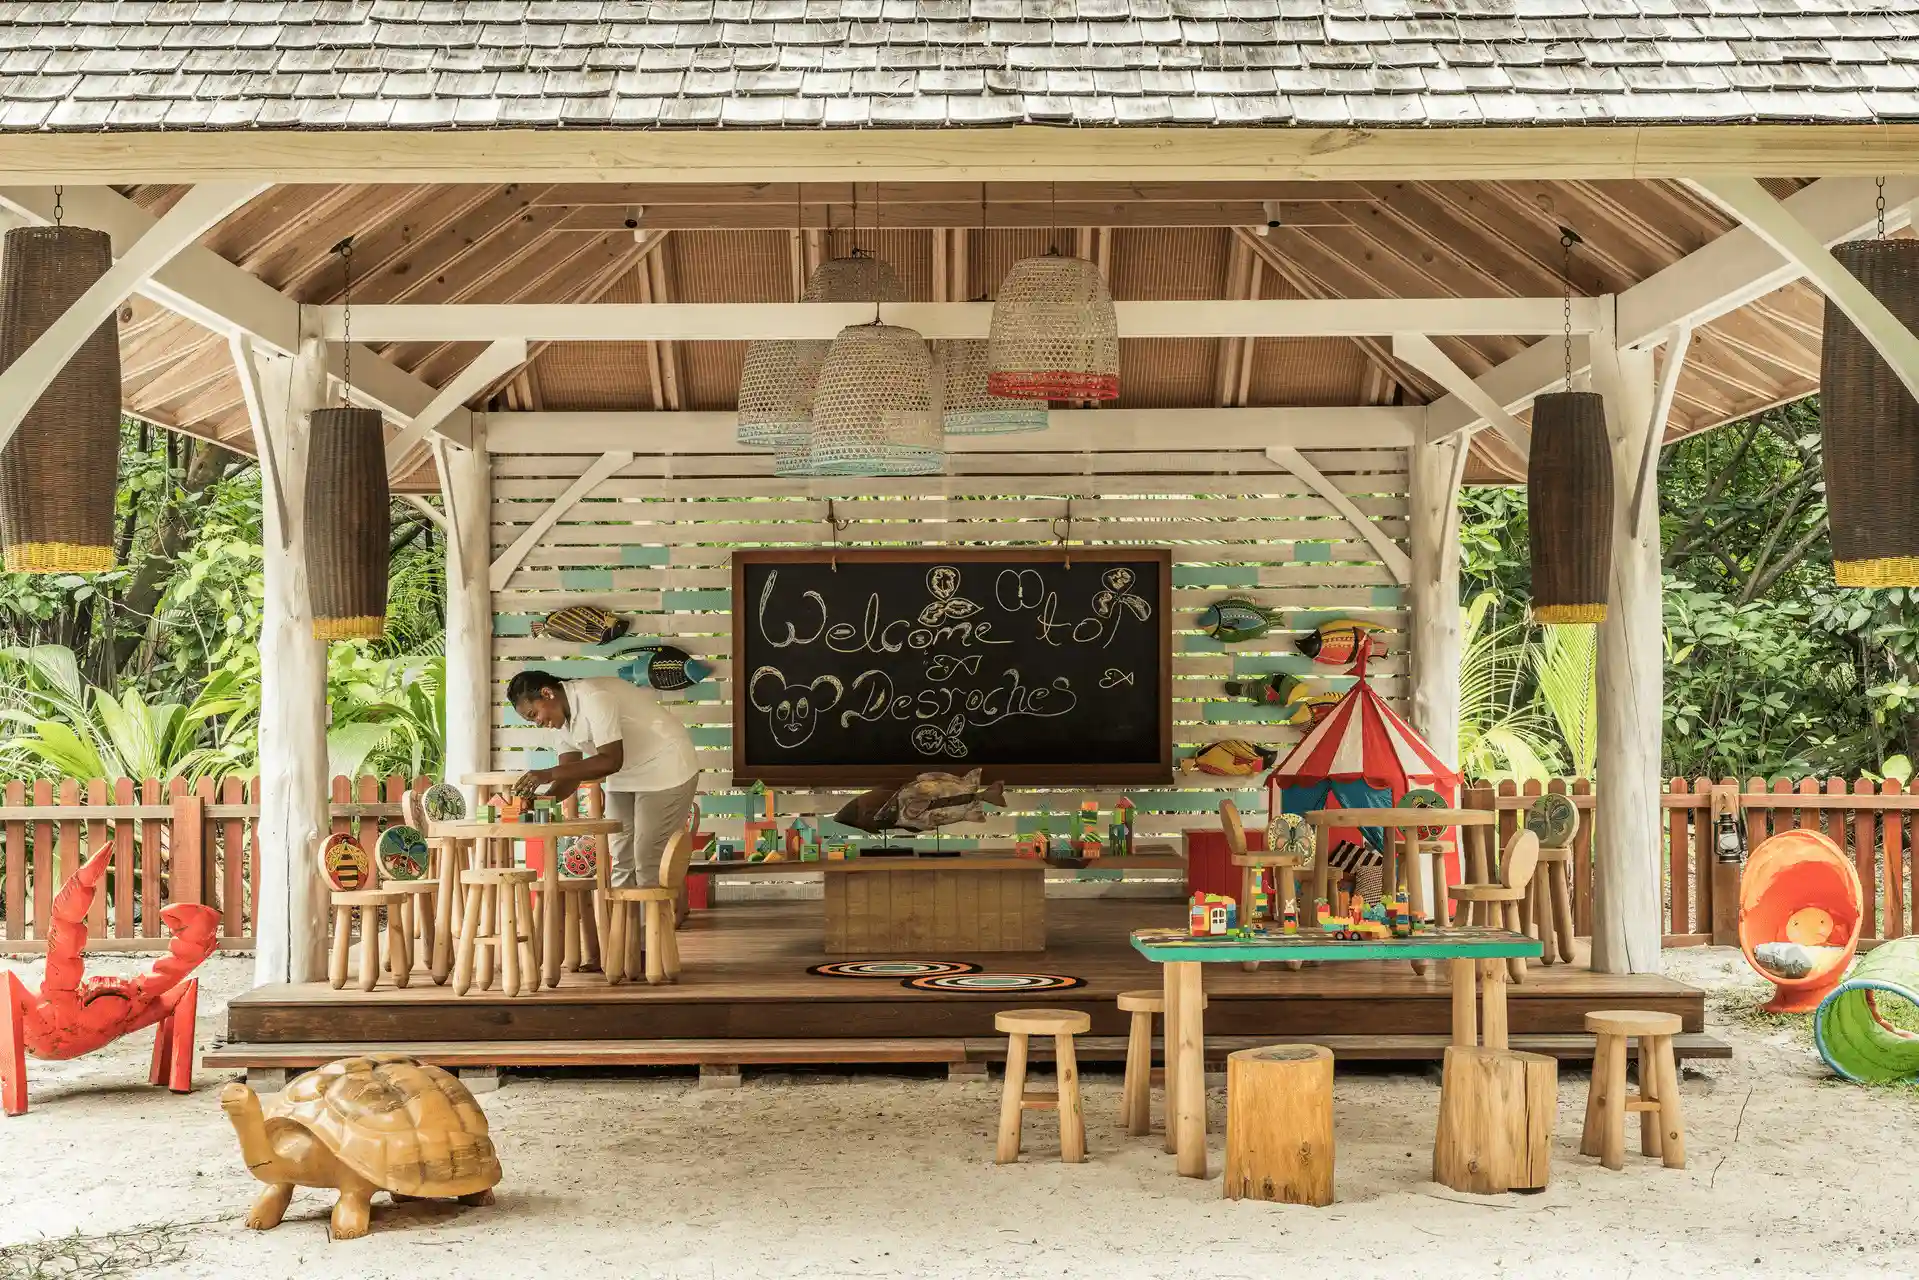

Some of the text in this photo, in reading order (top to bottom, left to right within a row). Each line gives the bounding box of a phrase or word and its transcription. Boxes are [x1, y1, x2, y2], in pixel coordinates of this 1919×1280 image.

[759, 569, 1104, 653] Welcome to
[840, 668, 1077, 728] Desroches
